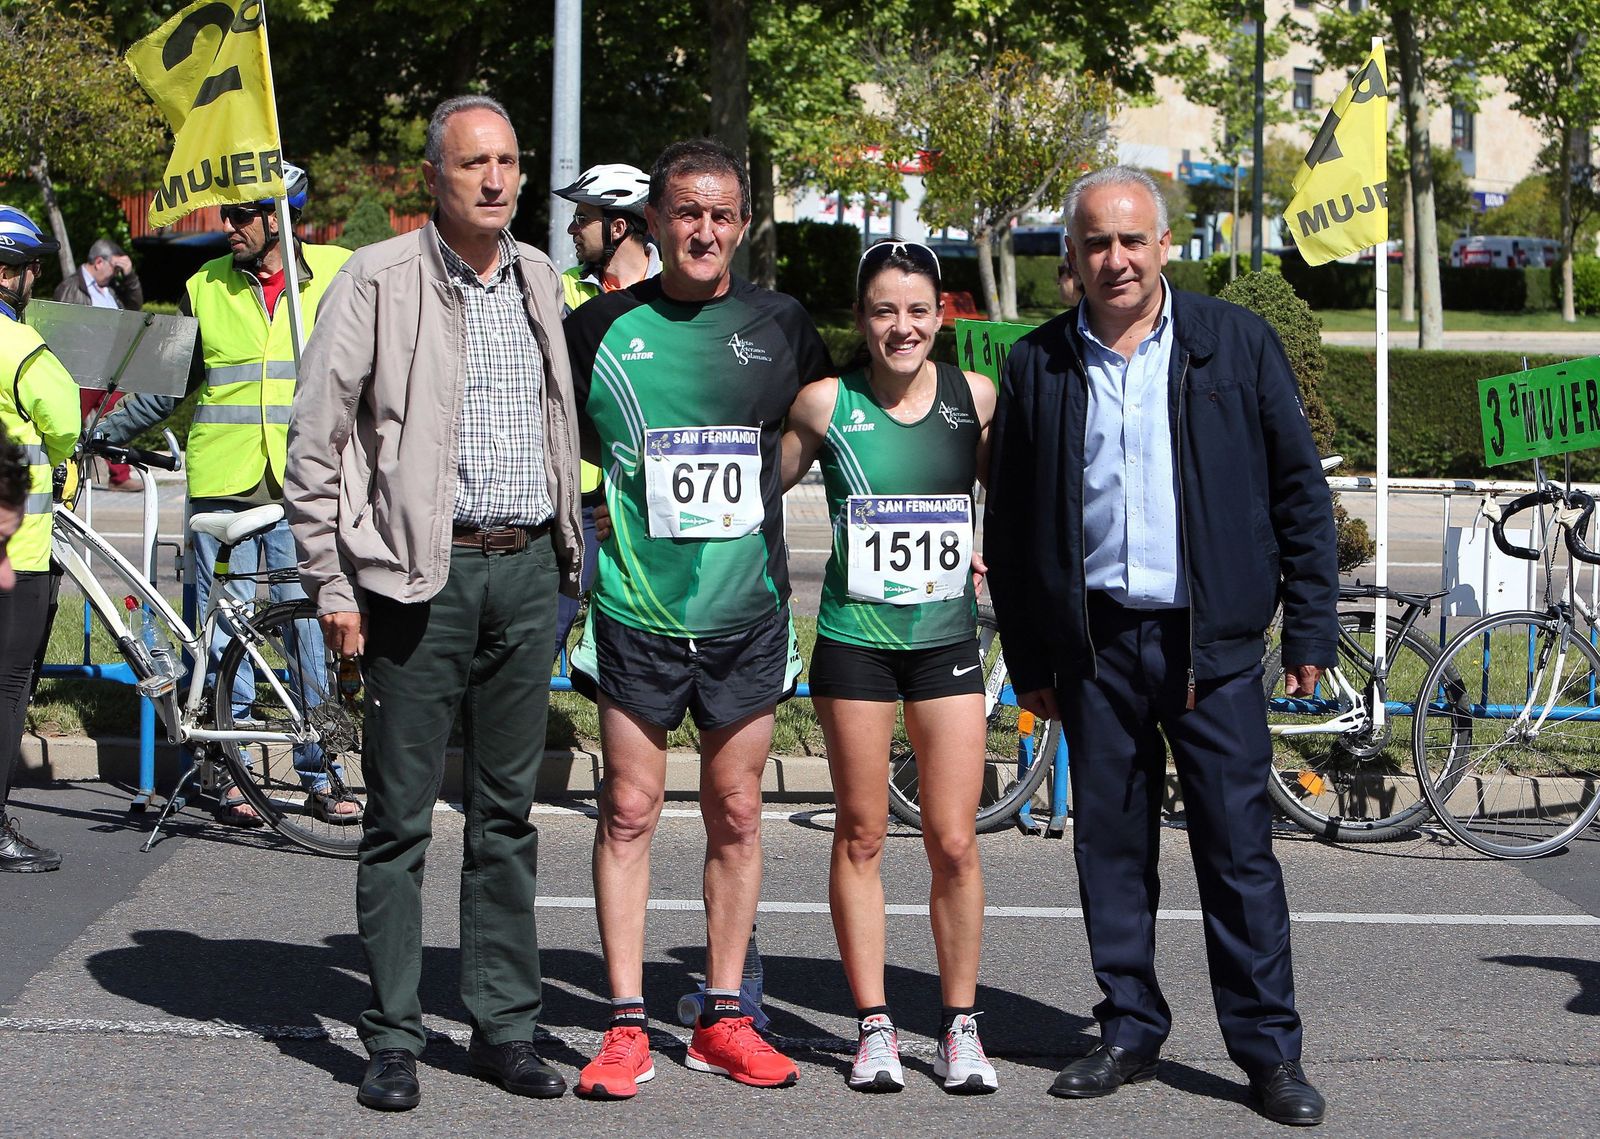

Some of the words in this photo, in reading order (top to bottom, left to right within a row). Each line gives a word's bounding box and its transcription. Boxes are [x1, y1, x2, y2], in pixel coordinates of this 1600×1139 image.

[155, 149, 283, 212] MUJER
[1297, 181, 1388, 238] MUJE
[621, 352, 654, 361] VIATOR
[842, 423, 875, 433] VIATOR
[1522, 379, 1600, 443] MUJER
[673, 431, 699, 444] SAN
[702, 430, 756, 444] FERNANDO
[672, 462, 742, 504] 670
[877, 500, 903, 513] SAN
[906, 498, 966, 513] FERNANDO
[865, 530, 961, 572] 1518
